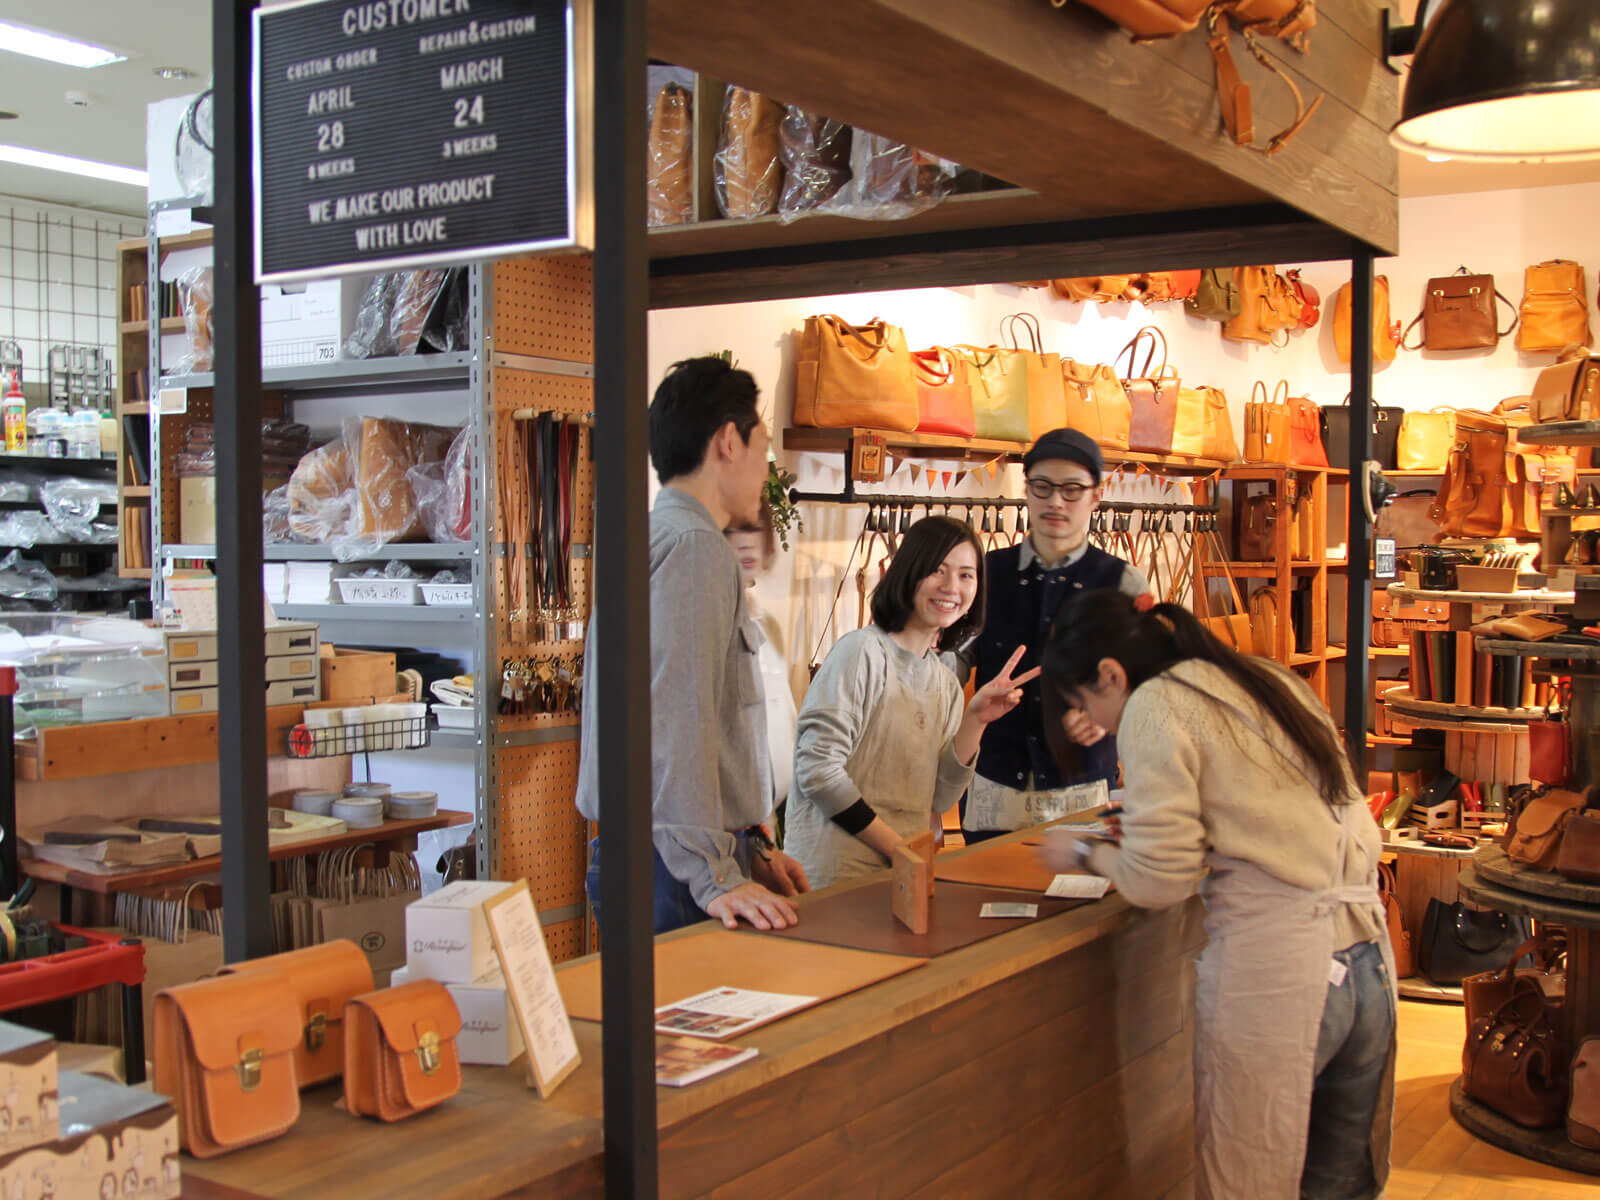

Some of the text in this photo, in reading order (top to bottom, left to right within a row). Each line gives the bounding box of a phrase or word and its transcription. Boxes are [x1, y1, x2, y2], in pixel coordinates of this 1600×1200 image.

[287, 48, 378, 80] CUSTOM ORDER
[441, 56, 503, 89] MARCH
[307, 85, 355, 115] APRIL
[454, 95, 484, 128] 24
[318, 120, 345, 152] 28
[453, 134, 497, 156] WEEKS
[318, 157, 355, 178] WEEKS
[308, 174, 495, 224] WE MAKE OUR PRODUCT
[356, 217, 447, 251] WITH LOVE
[319, 347, 335, 359] 703
